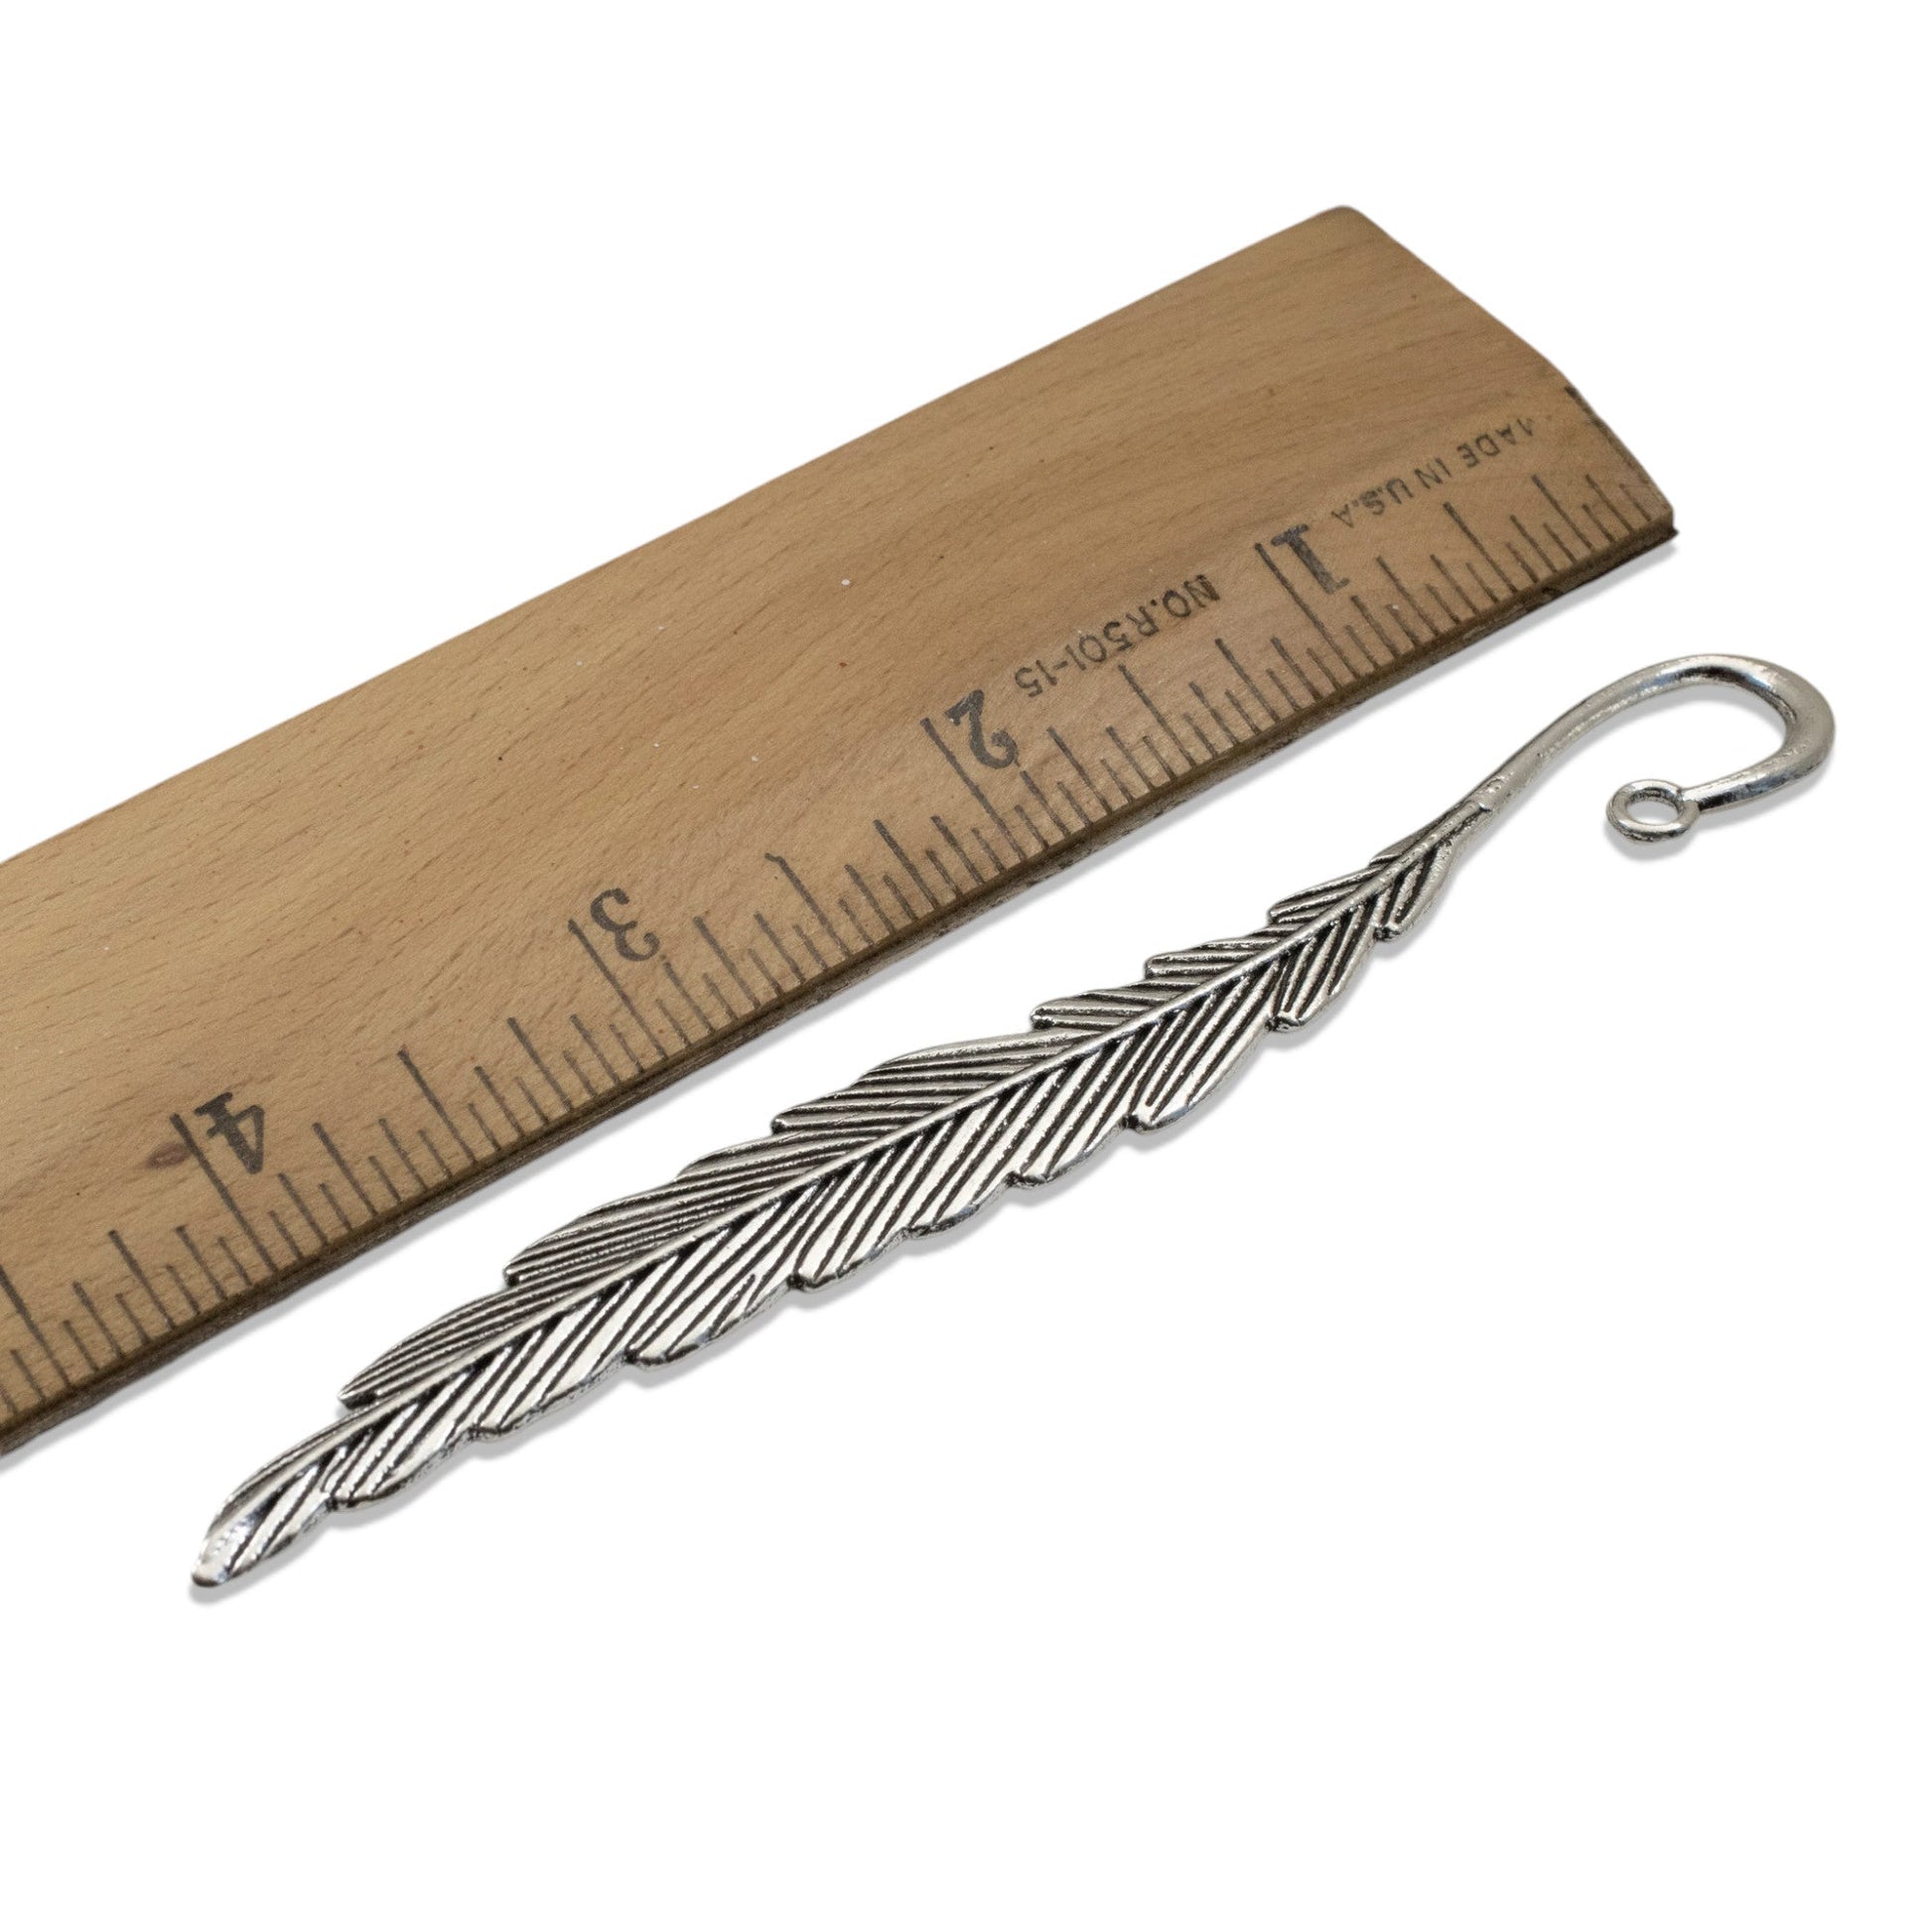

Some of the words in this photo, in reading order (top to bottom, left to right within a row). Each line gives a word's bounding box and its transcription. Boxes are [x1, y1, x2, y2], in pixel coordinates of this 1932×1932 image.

[1414, 458, 1452, 489] IN
[1272, 524, 1350, 594] 1
[945, 689, 1020, 768] 2
[590, 888, 660, 962] 3
[194, 1092, 265, 1174] 4
